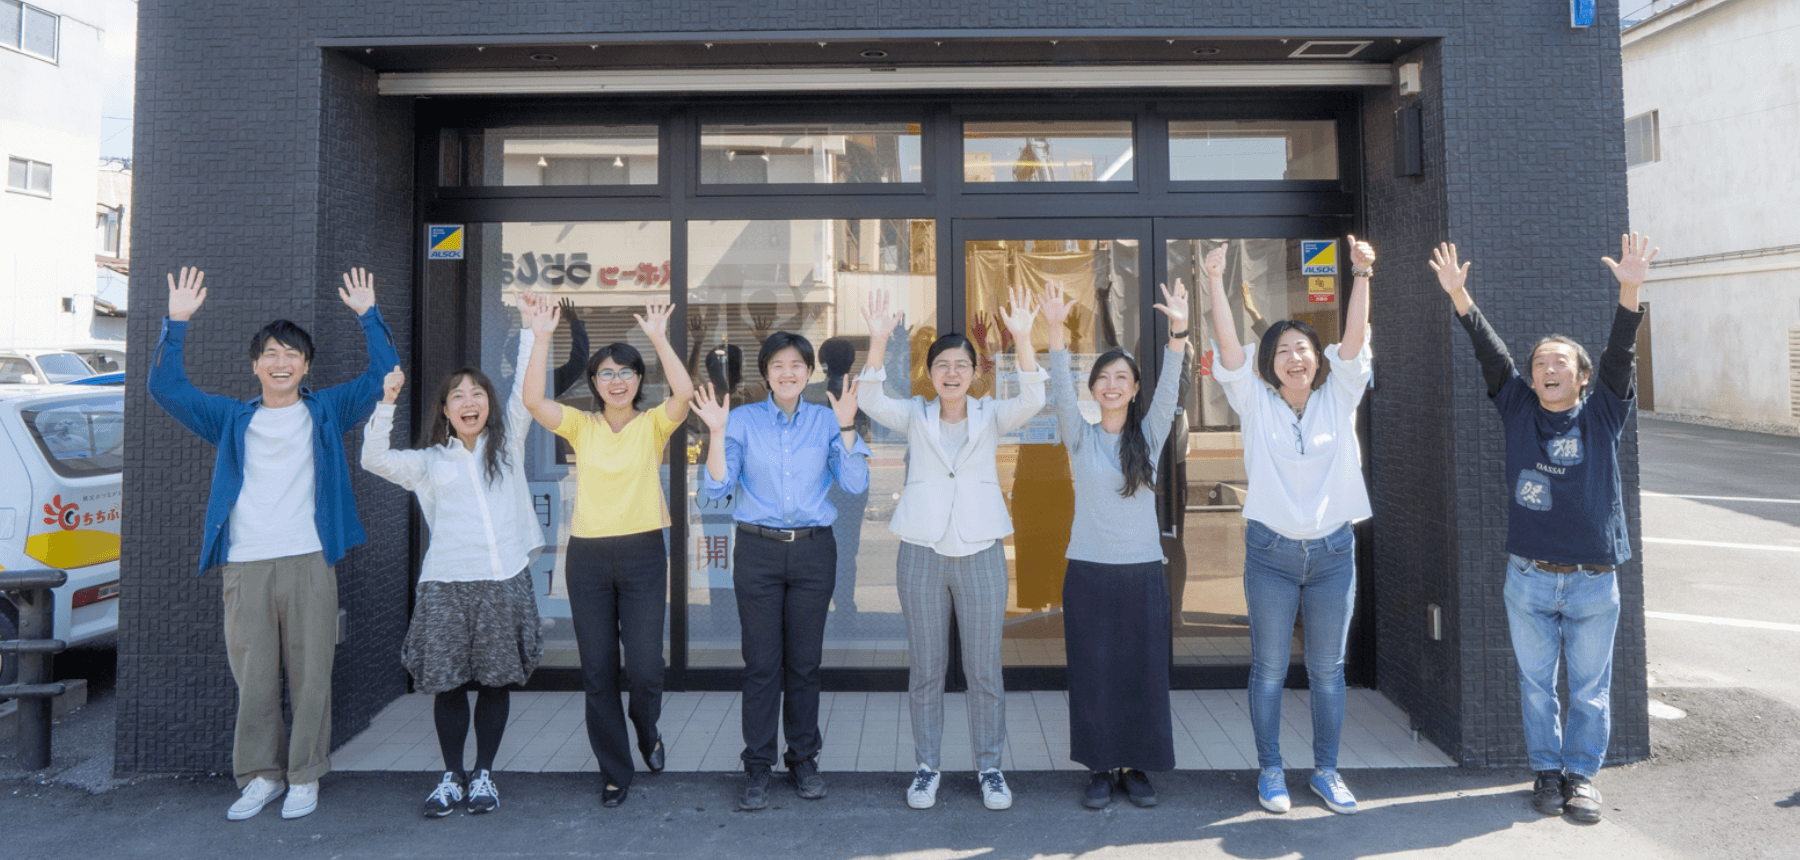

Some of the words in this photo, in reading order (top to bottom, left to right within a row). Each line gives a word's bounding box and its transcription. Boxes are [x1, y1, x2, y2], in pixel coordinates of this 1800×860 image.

[430, 250, 461, 258] ALSOK
[1536, 462, 1565, 474] DASSAI
[696, 535, 729, 570] 開
